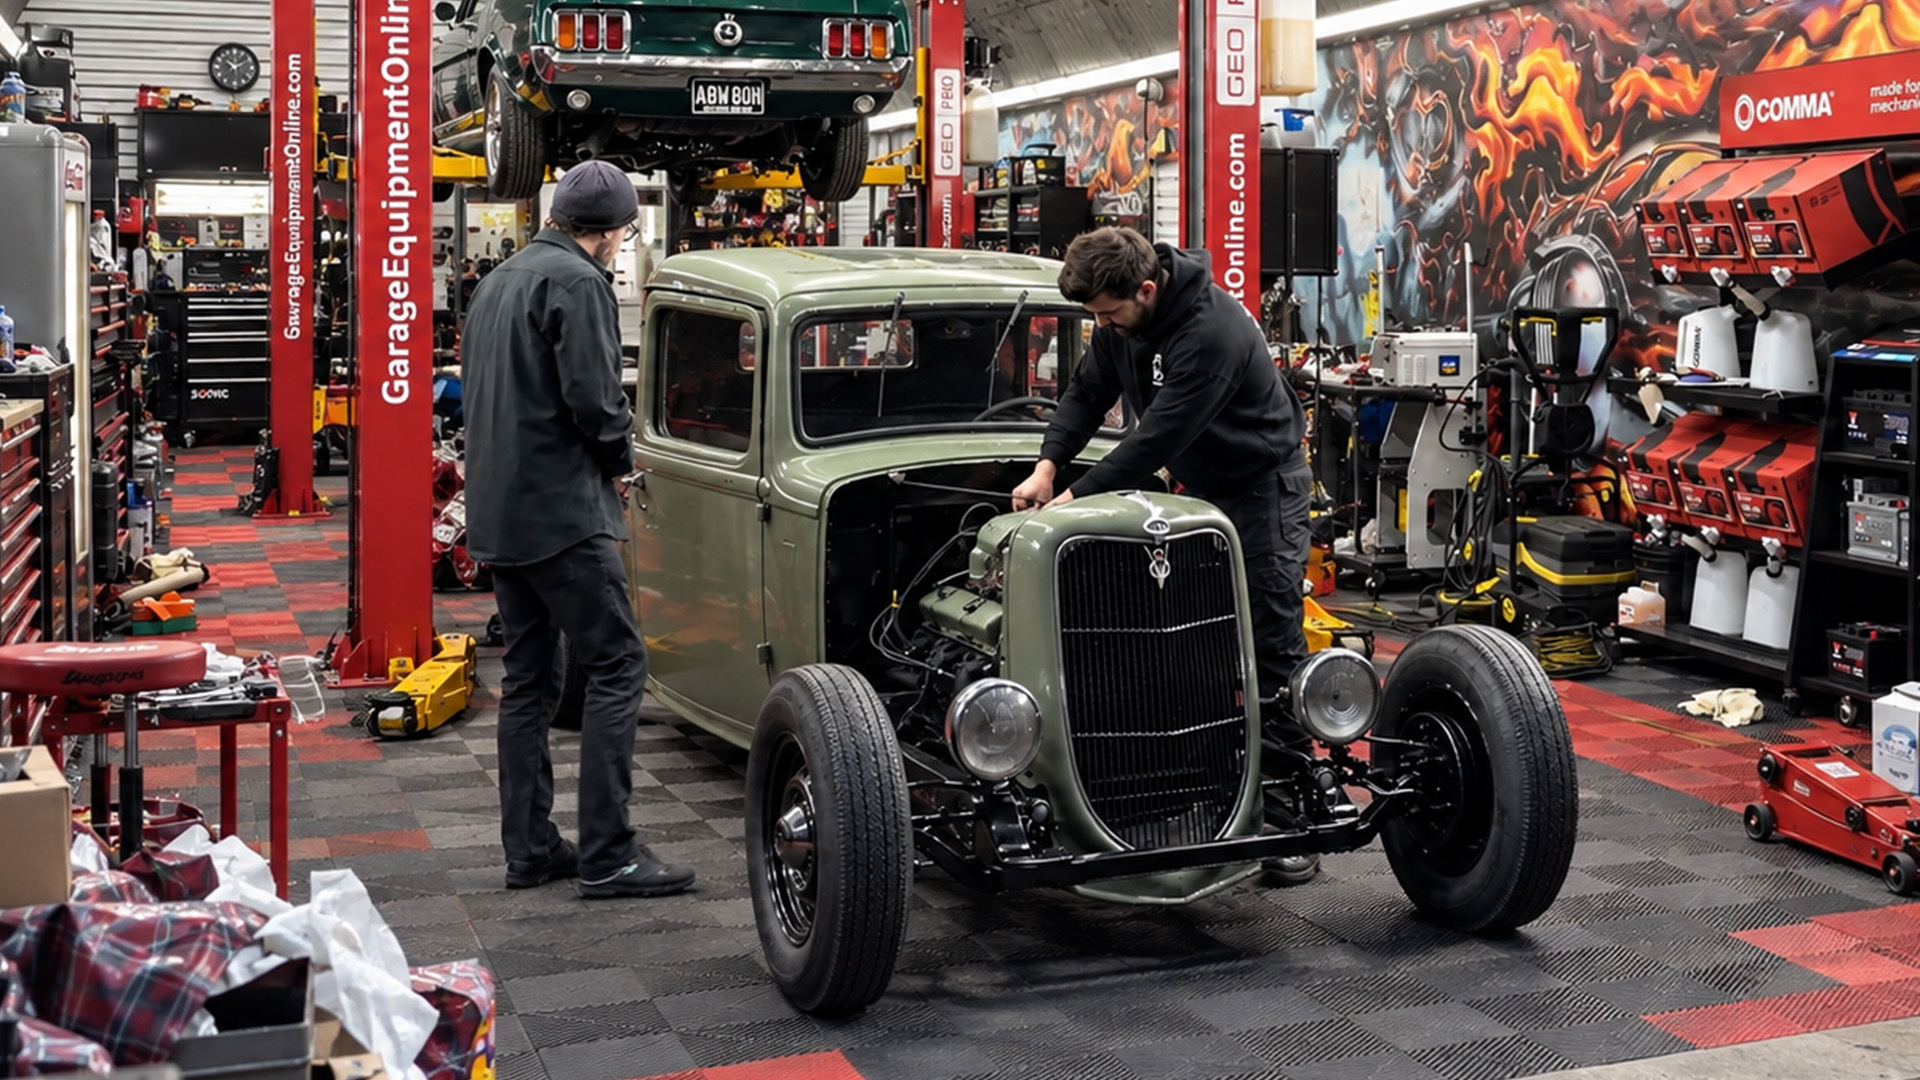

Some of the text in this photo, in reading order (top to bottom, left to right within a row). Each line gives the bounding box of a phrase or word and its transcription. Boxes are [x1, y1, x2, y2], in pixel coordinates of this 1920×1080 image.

[1227, 28, 1245, 98] GEO
[1756, 92, 1833, 123] COMMA
[1870, 80, 1903, 98] made
[941, 123, 954, 171] GEO
